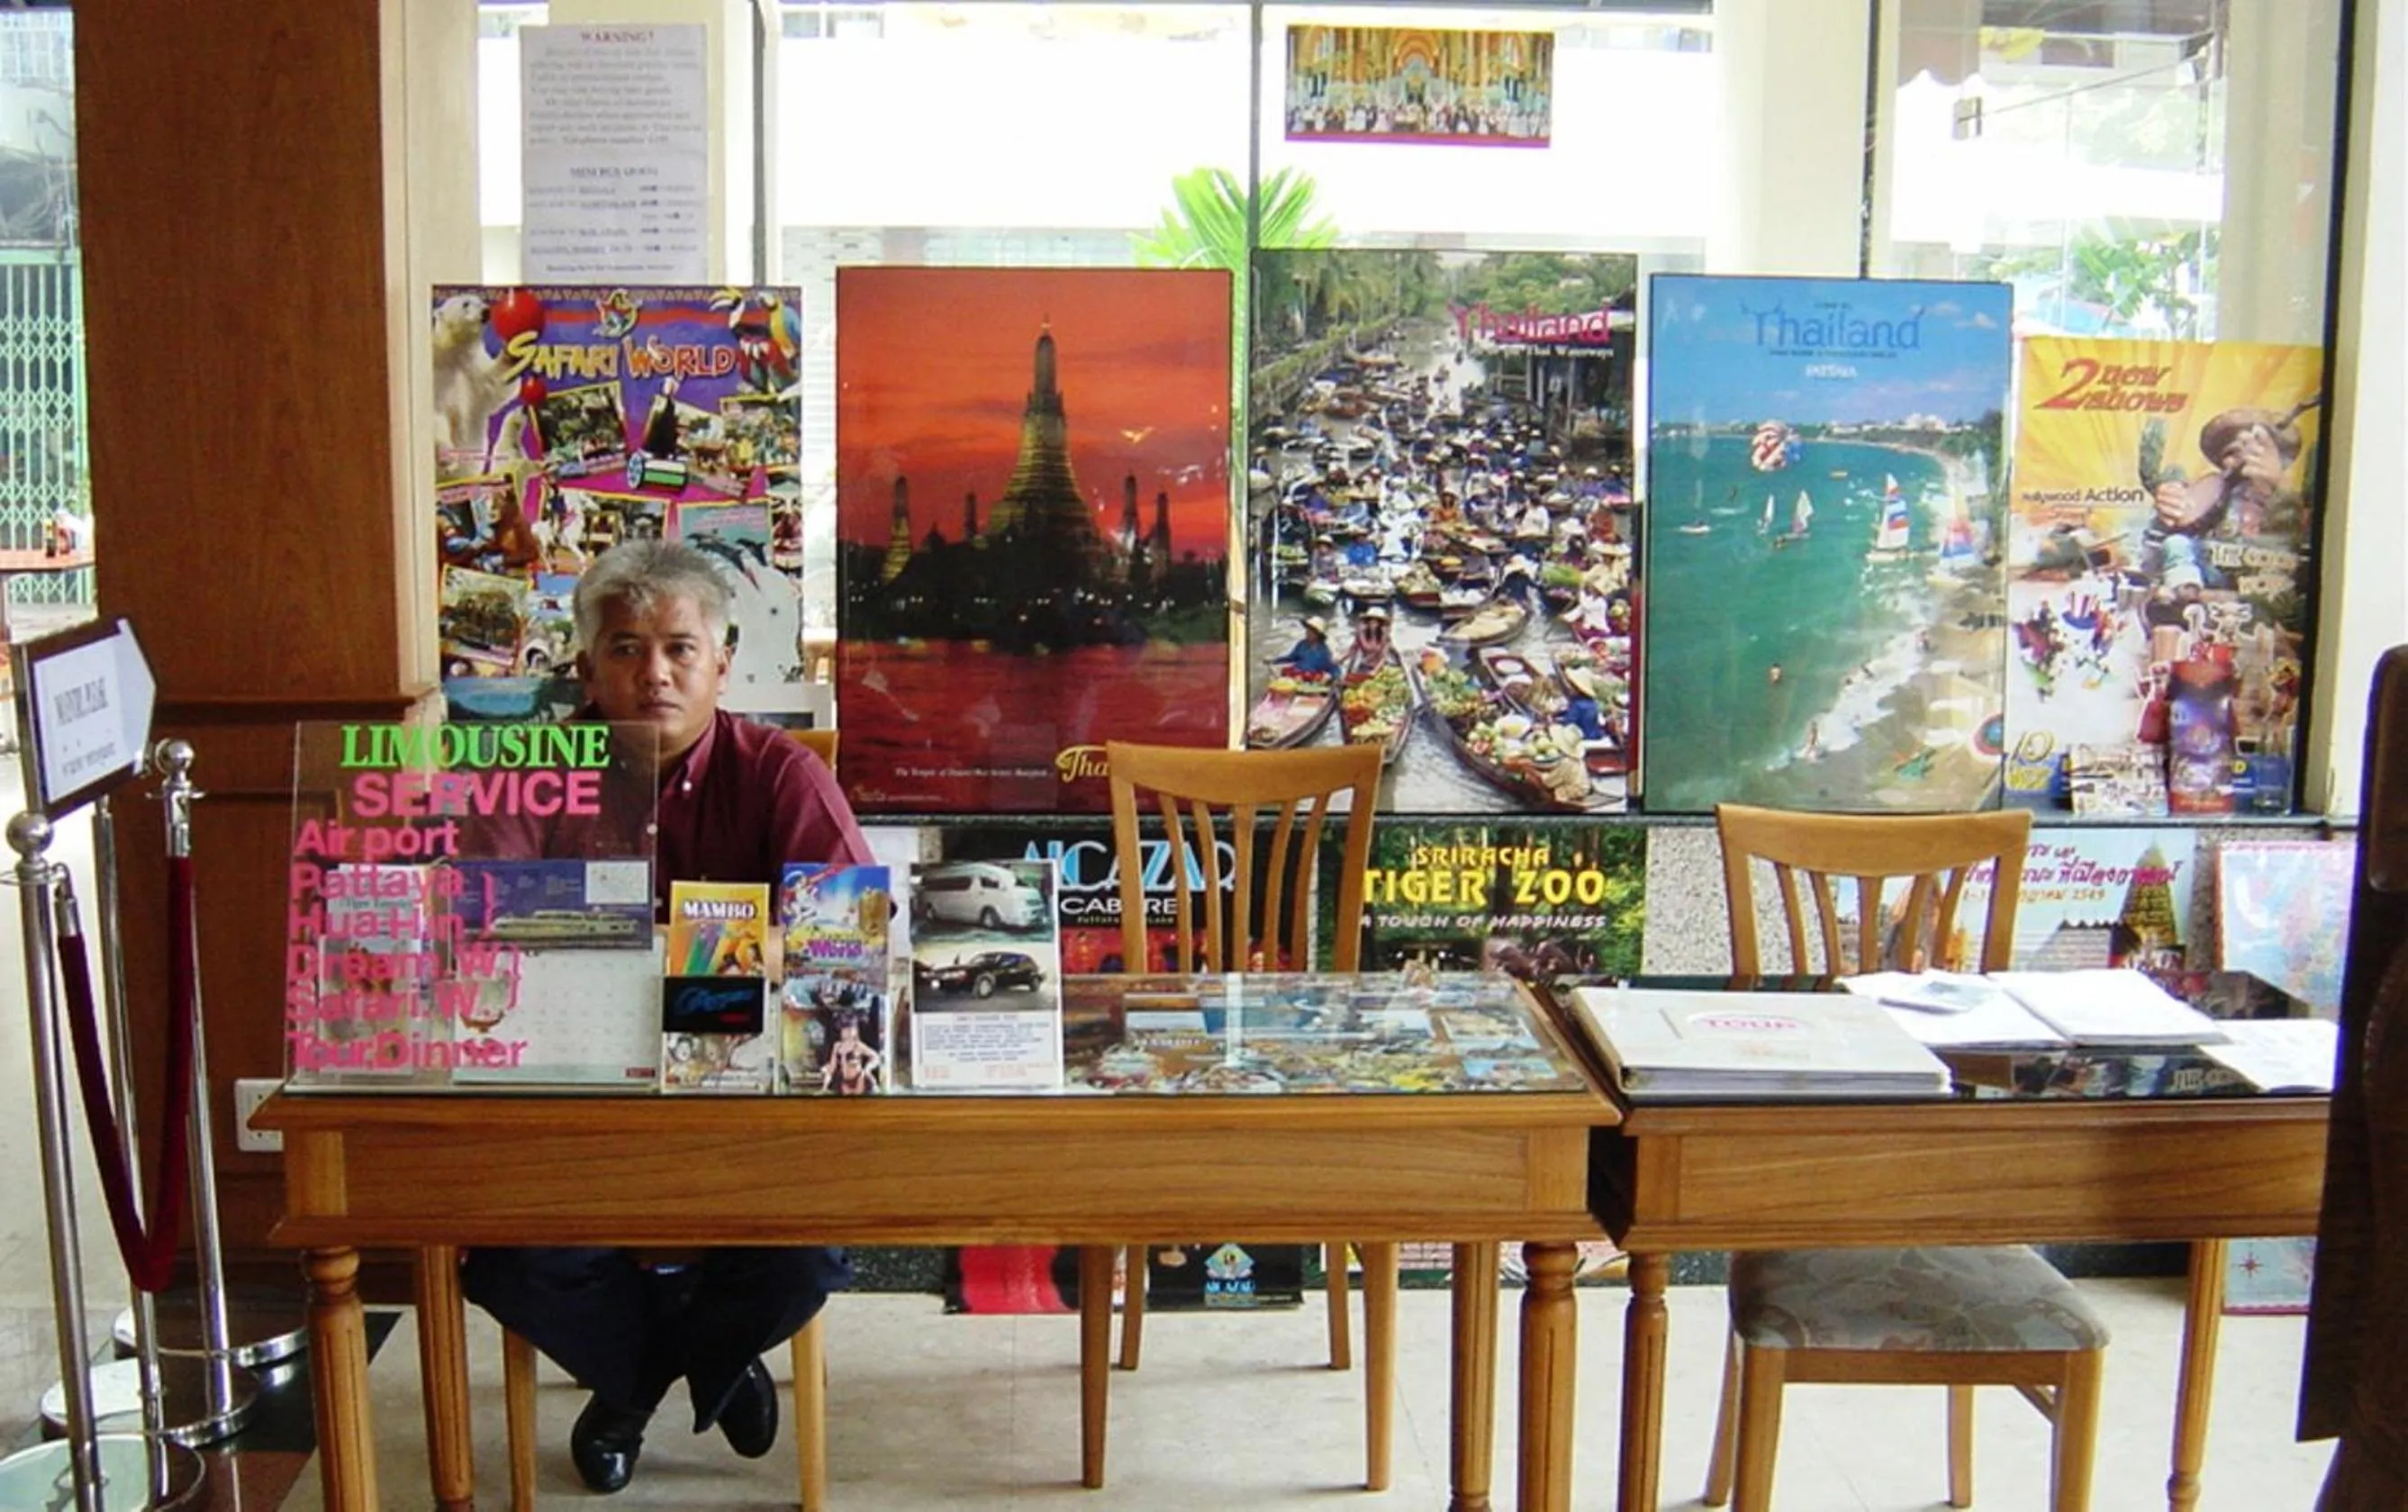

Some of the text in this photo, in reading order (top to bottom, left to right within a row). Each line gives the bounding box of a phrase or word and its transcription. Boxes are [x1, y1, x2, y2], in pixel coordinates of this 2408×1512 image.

[1447, 300, 1612, 344] Thailand
[1741, 298, 1926, 349] Thailand
[502, 330, 736, 381] SAFARI WORLD
[2032, 358, 2101, 411] 2
[2084, 486, 2145, 502] Action
[340, 724, 611, 768] LIMOUSINE
[352, 770, 602, 818] SERVICE
[1417, 847, 1551, 867] SRIRACHA
[290, 862, 466, 904] Pattaya
[1362, 869, 1607, 907] TIGER ZOO
[682, 901, 756, 919] MAMBO
[1060, 898, 1178, 916] CABRE
[1378, 914, 1449, 928] TOUCH
[1456, 914, 1482, 928] OF
[1489, 914, 1607, 929] HAPPINESS
